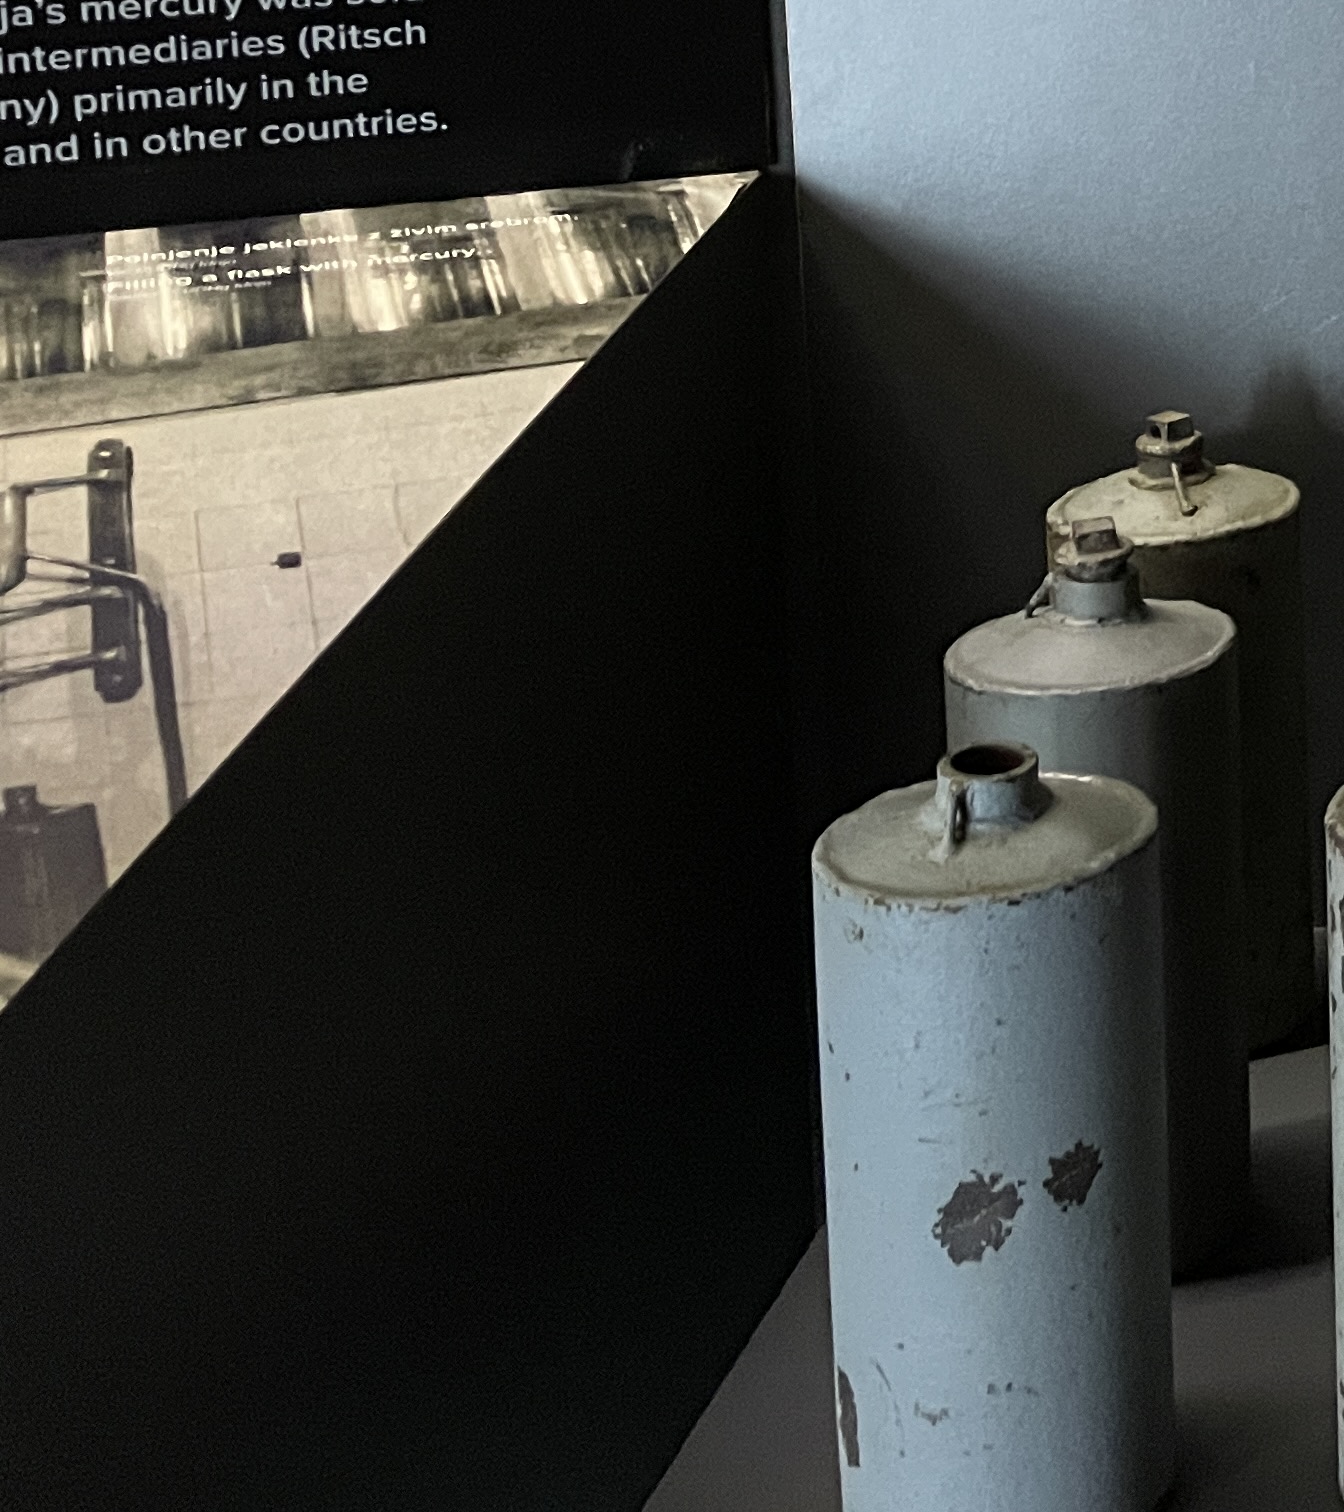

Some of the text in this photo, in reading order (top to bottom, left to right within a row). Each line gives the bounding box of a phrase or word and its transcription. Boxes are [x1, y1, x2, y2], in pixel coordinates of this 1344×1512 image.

[299, 20, 425, 59] (Ritsch
[74, 70, 368, 121] primarily in the
[5, 109, 447, 166] and in other countries.
